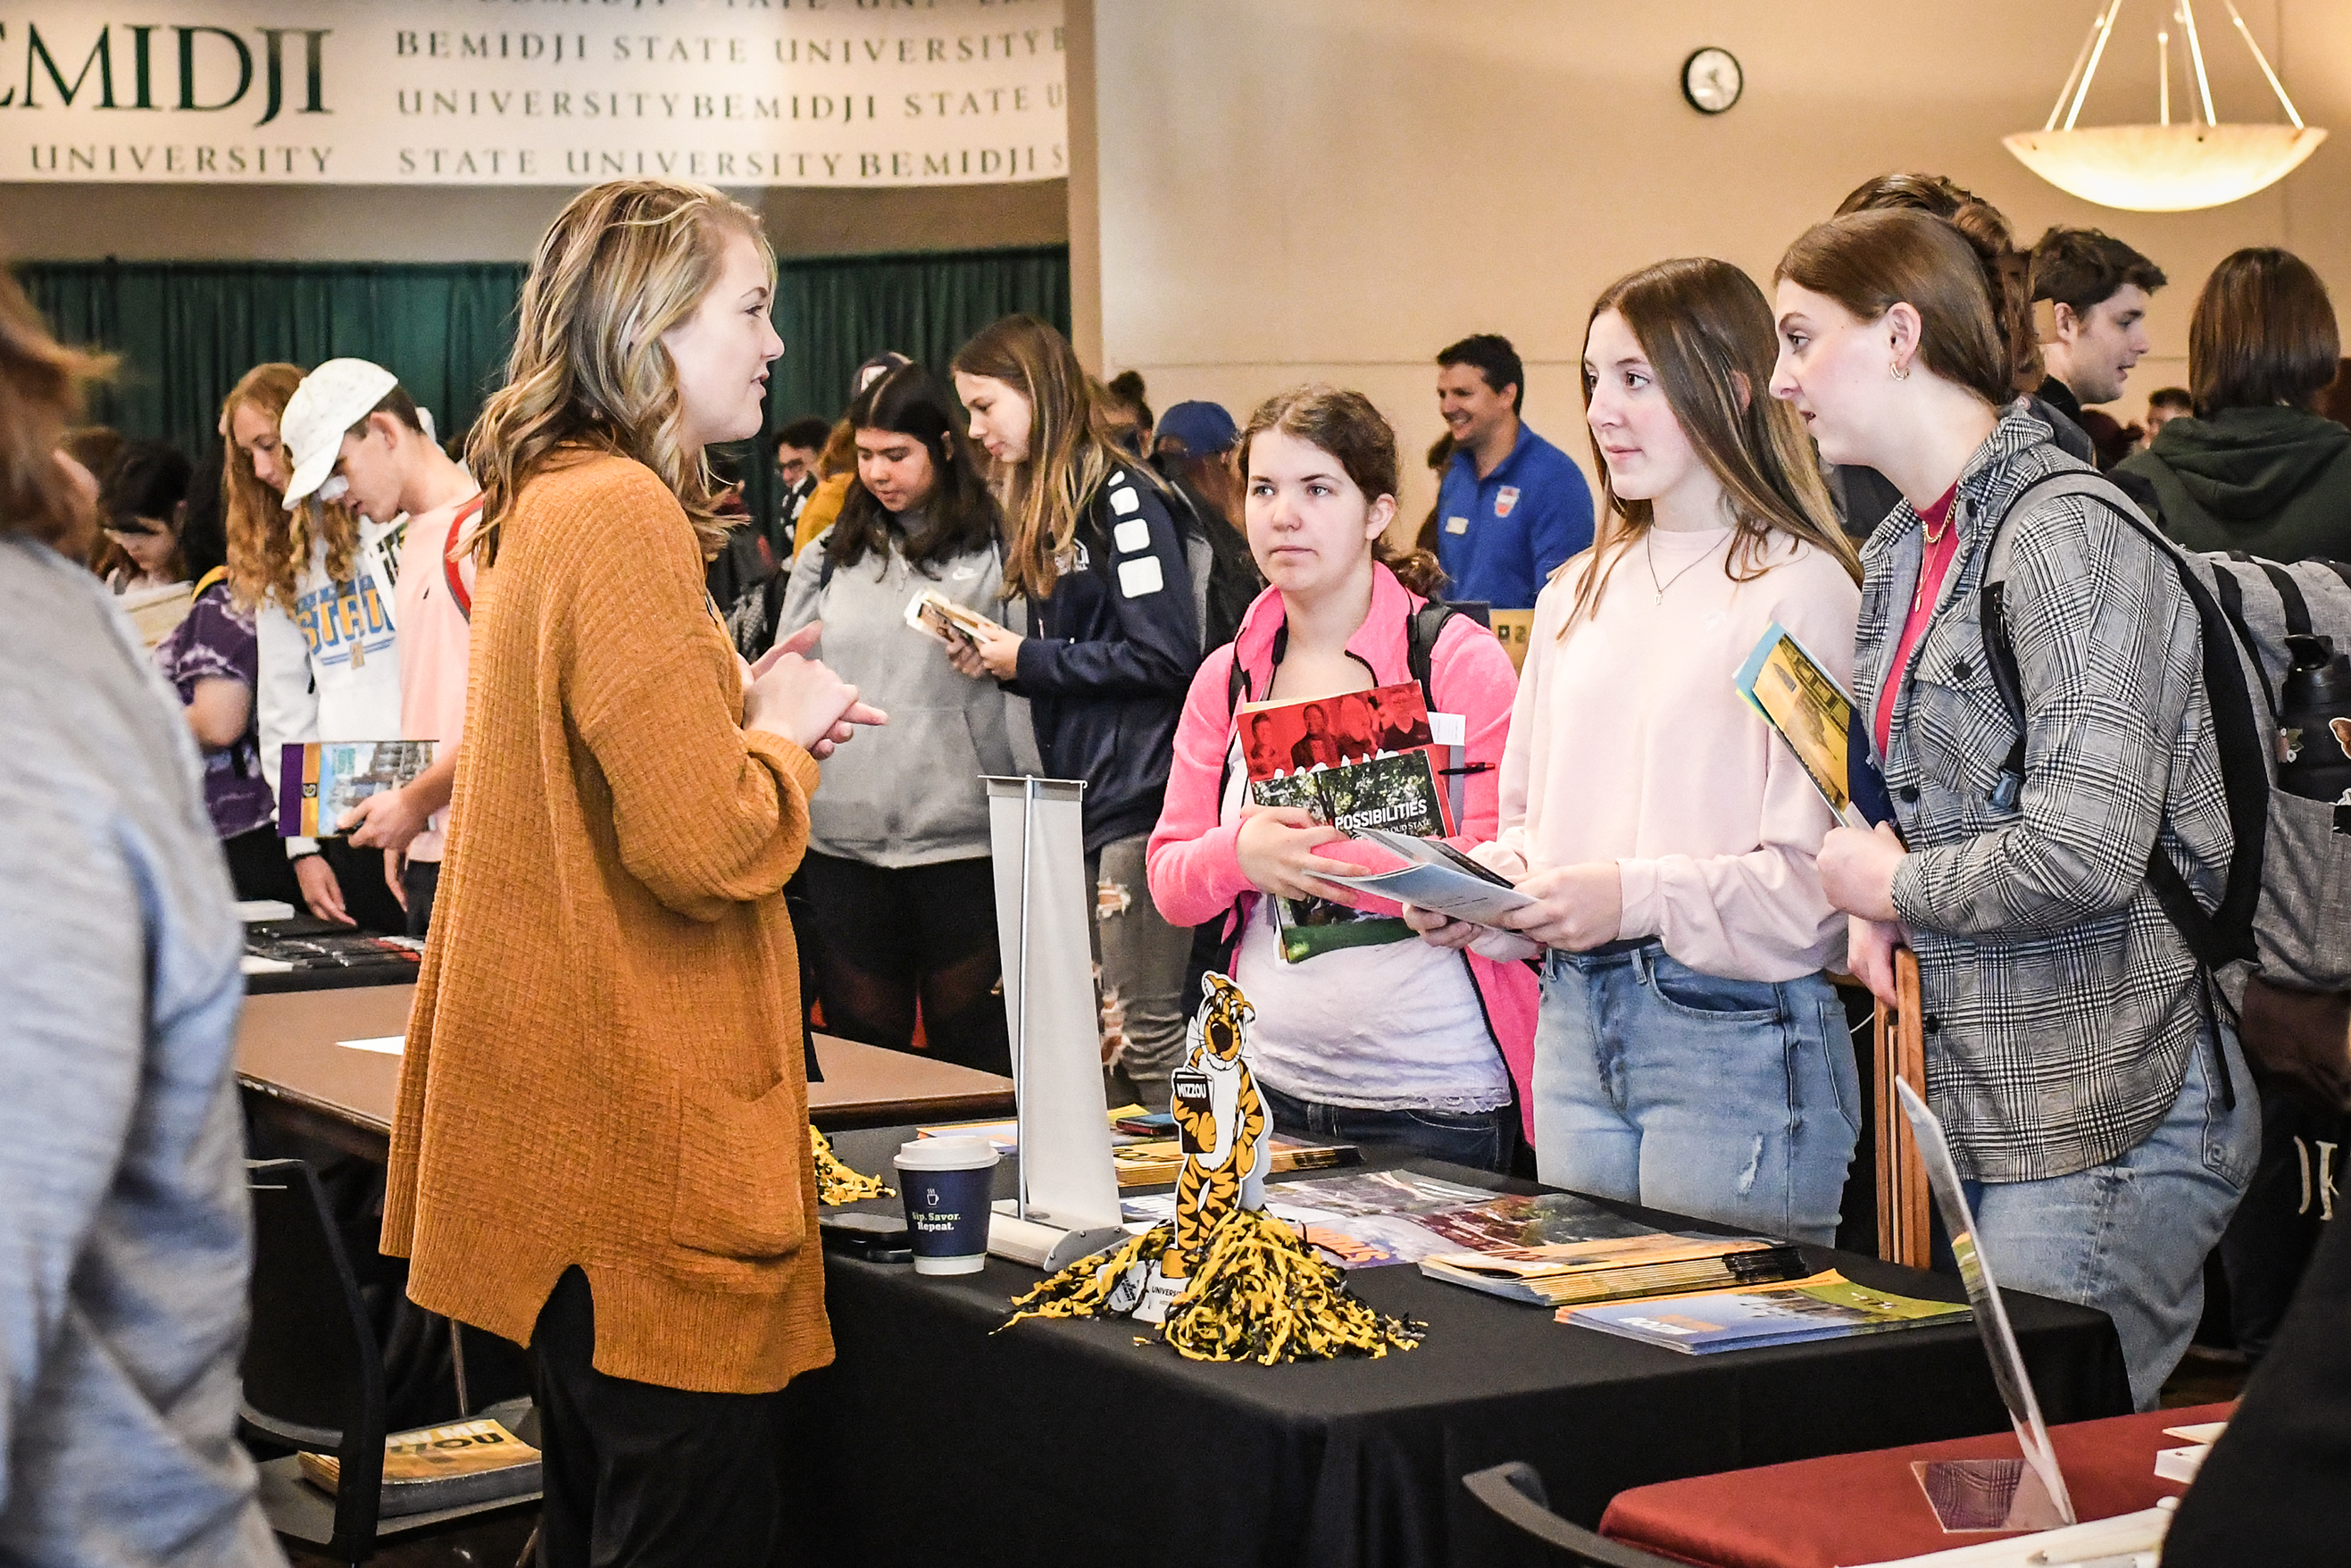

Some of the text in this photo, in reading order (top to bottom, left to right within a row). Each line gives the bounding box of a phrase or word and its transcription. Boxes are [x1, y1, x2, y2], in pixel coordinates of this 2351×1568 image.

[396, 30, 586, 64] BEMIDJI
[613, 36, 746, 63] STATE
[905, 88, 1029, 117] STATE
[30, 144, 334, 174] UNIVERSITY
[399, 148, 538, 175] STATE
[1335, 799, 1427, 830] POSSIBILITIES
[1407, 818, 1431, 830] STATE
[1177, 1083, 1206, 1098] MIZZOU
[917, 1222, 955, 1232] Repeat.
[928, 1212, 961, 1222] Savor.
